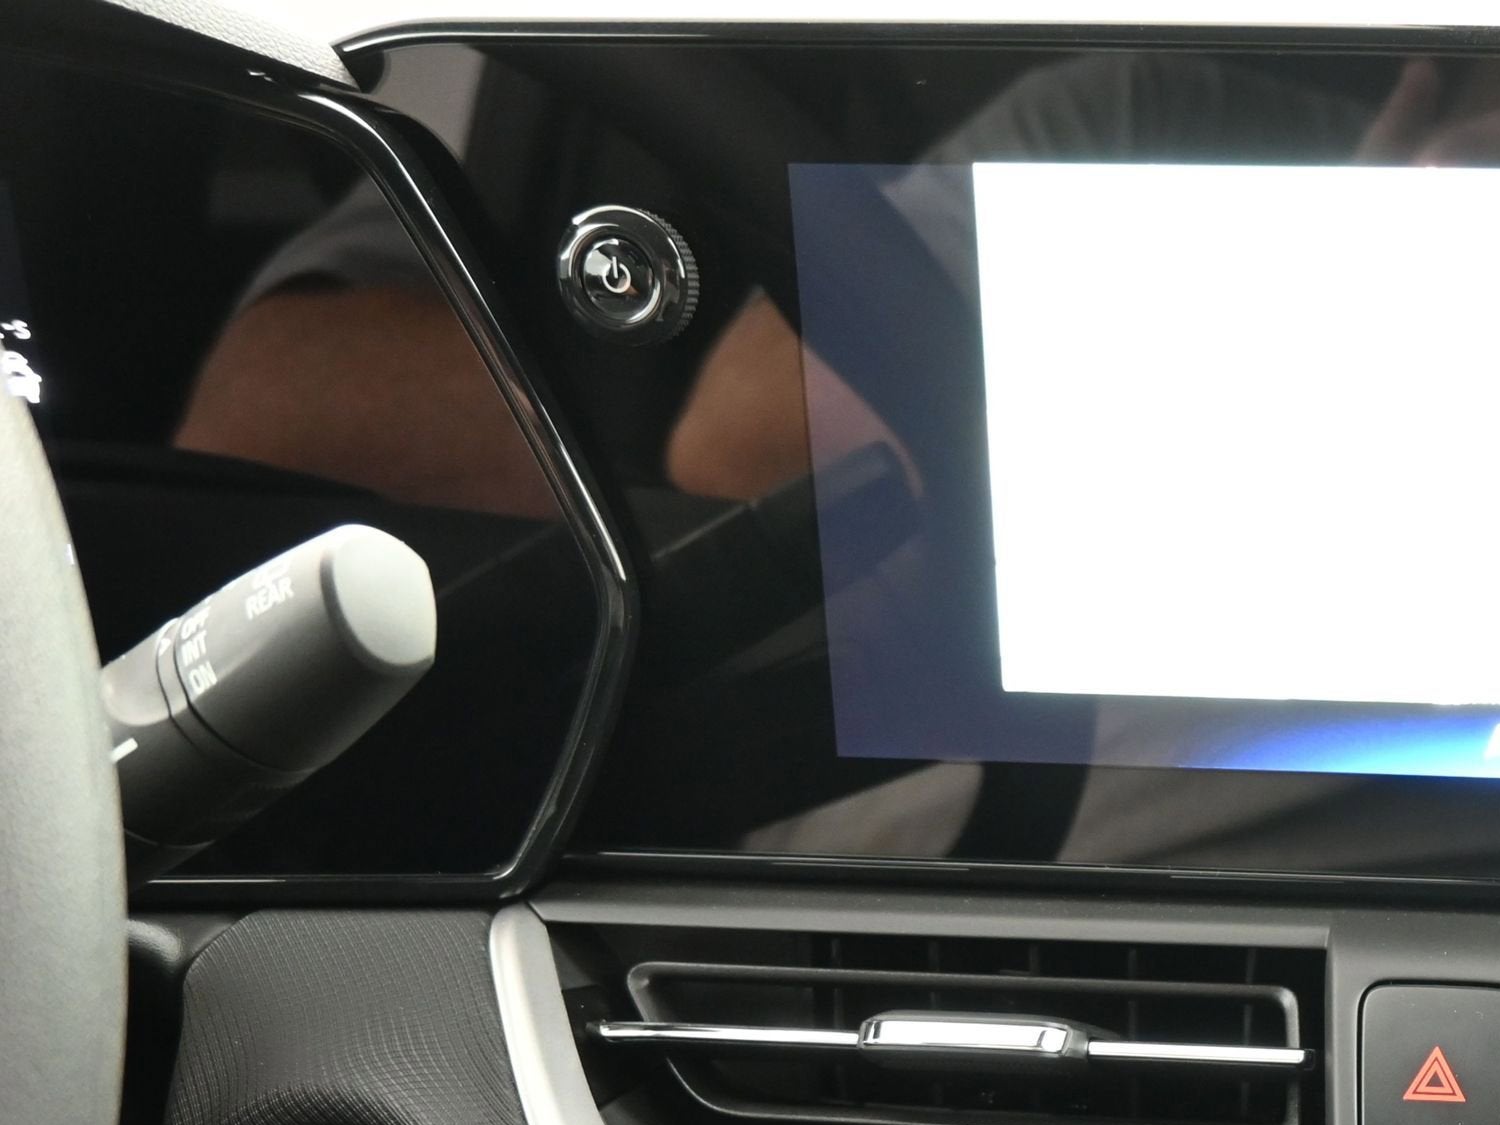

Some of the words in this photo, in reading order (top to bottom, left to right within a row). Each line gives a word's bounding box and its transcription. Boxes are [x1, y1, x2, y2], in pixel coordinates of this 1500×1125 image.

[246, 577, 294, 620] REAR
[181, 606, 212, 640] OFF
[181, 630, 207, 668] INT
[189, 661, 218, 695] ON
